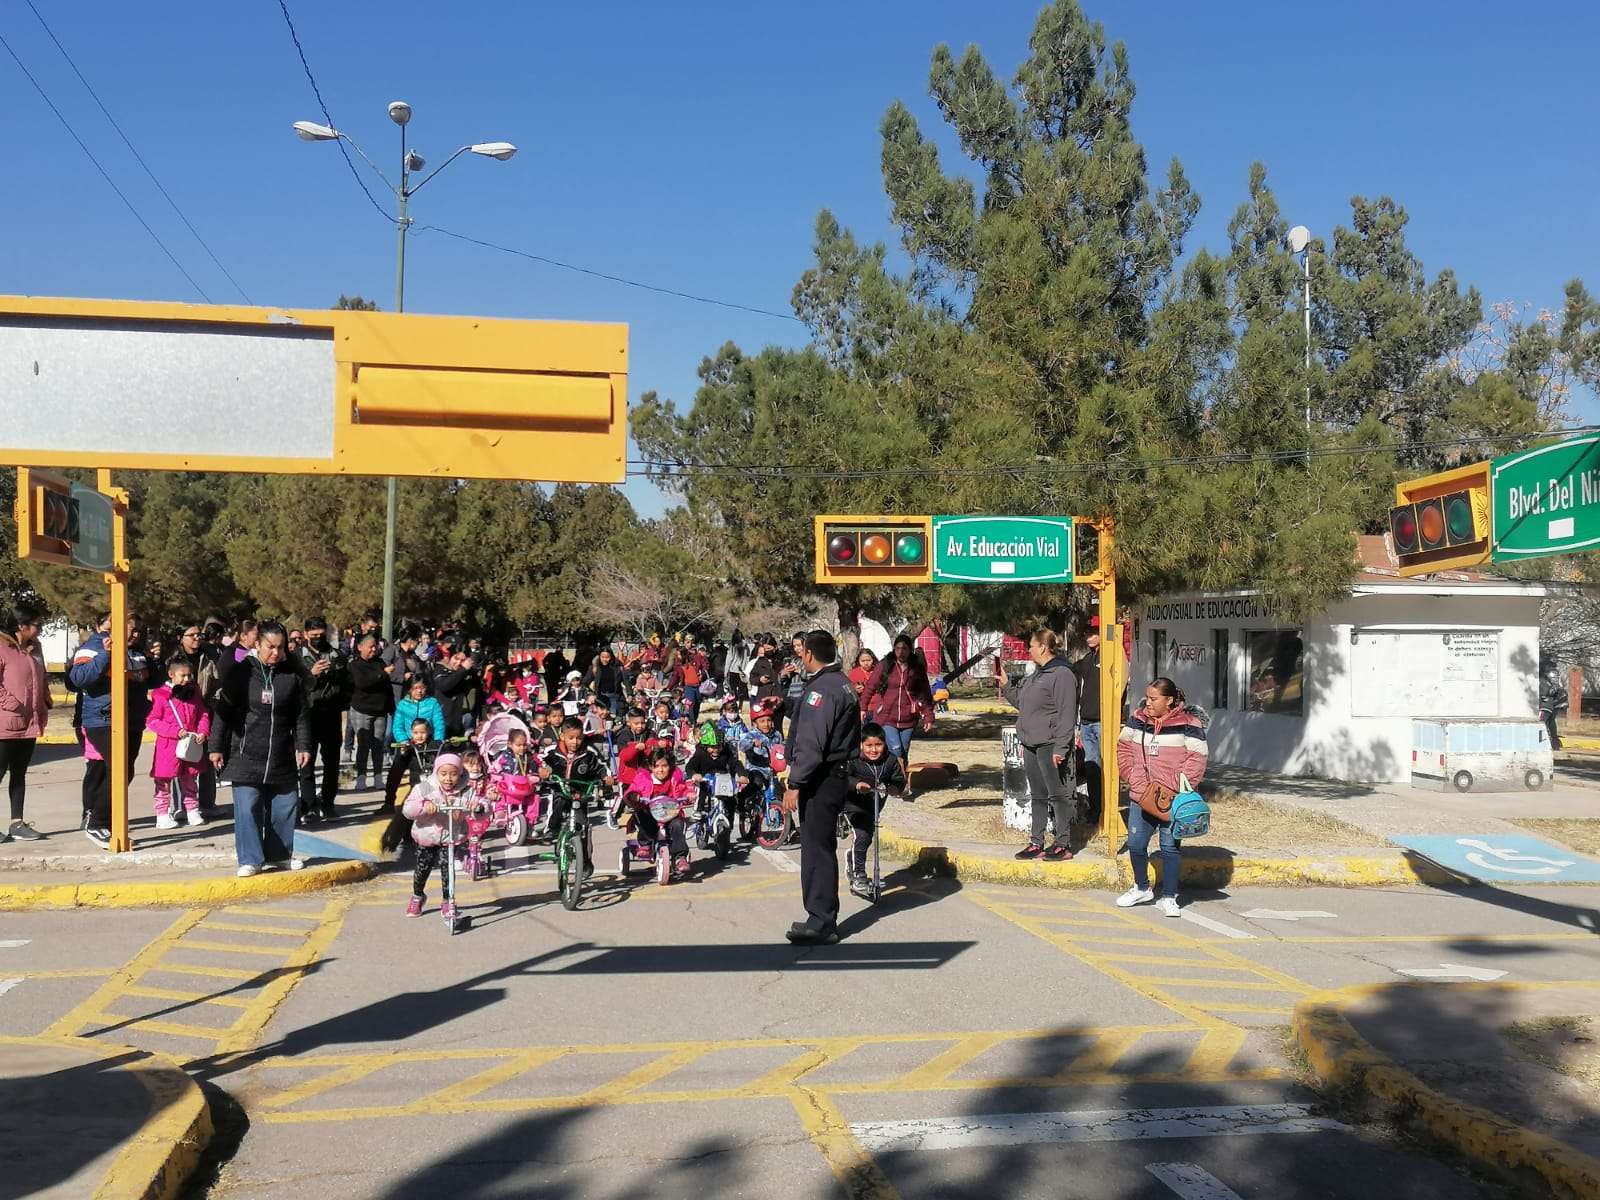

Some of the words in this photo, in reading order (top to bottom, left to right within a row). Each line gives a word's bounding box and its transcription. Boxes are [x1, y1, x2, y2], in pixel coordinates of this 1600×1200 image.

[1509, 482, 1545, 519] Blvd.
[1549, 475, 1574, 511] Del
[1581, 469, 1600, 506] Ni
[947, 536, 966, 557] Av.
[969, 536, 1034, 557] Educación
[1036, 537, 1059, 557] Vial
[1147, 602, 1193, 621] AUDIOVISUAL
[1195, 602, 1205, 619] DE
